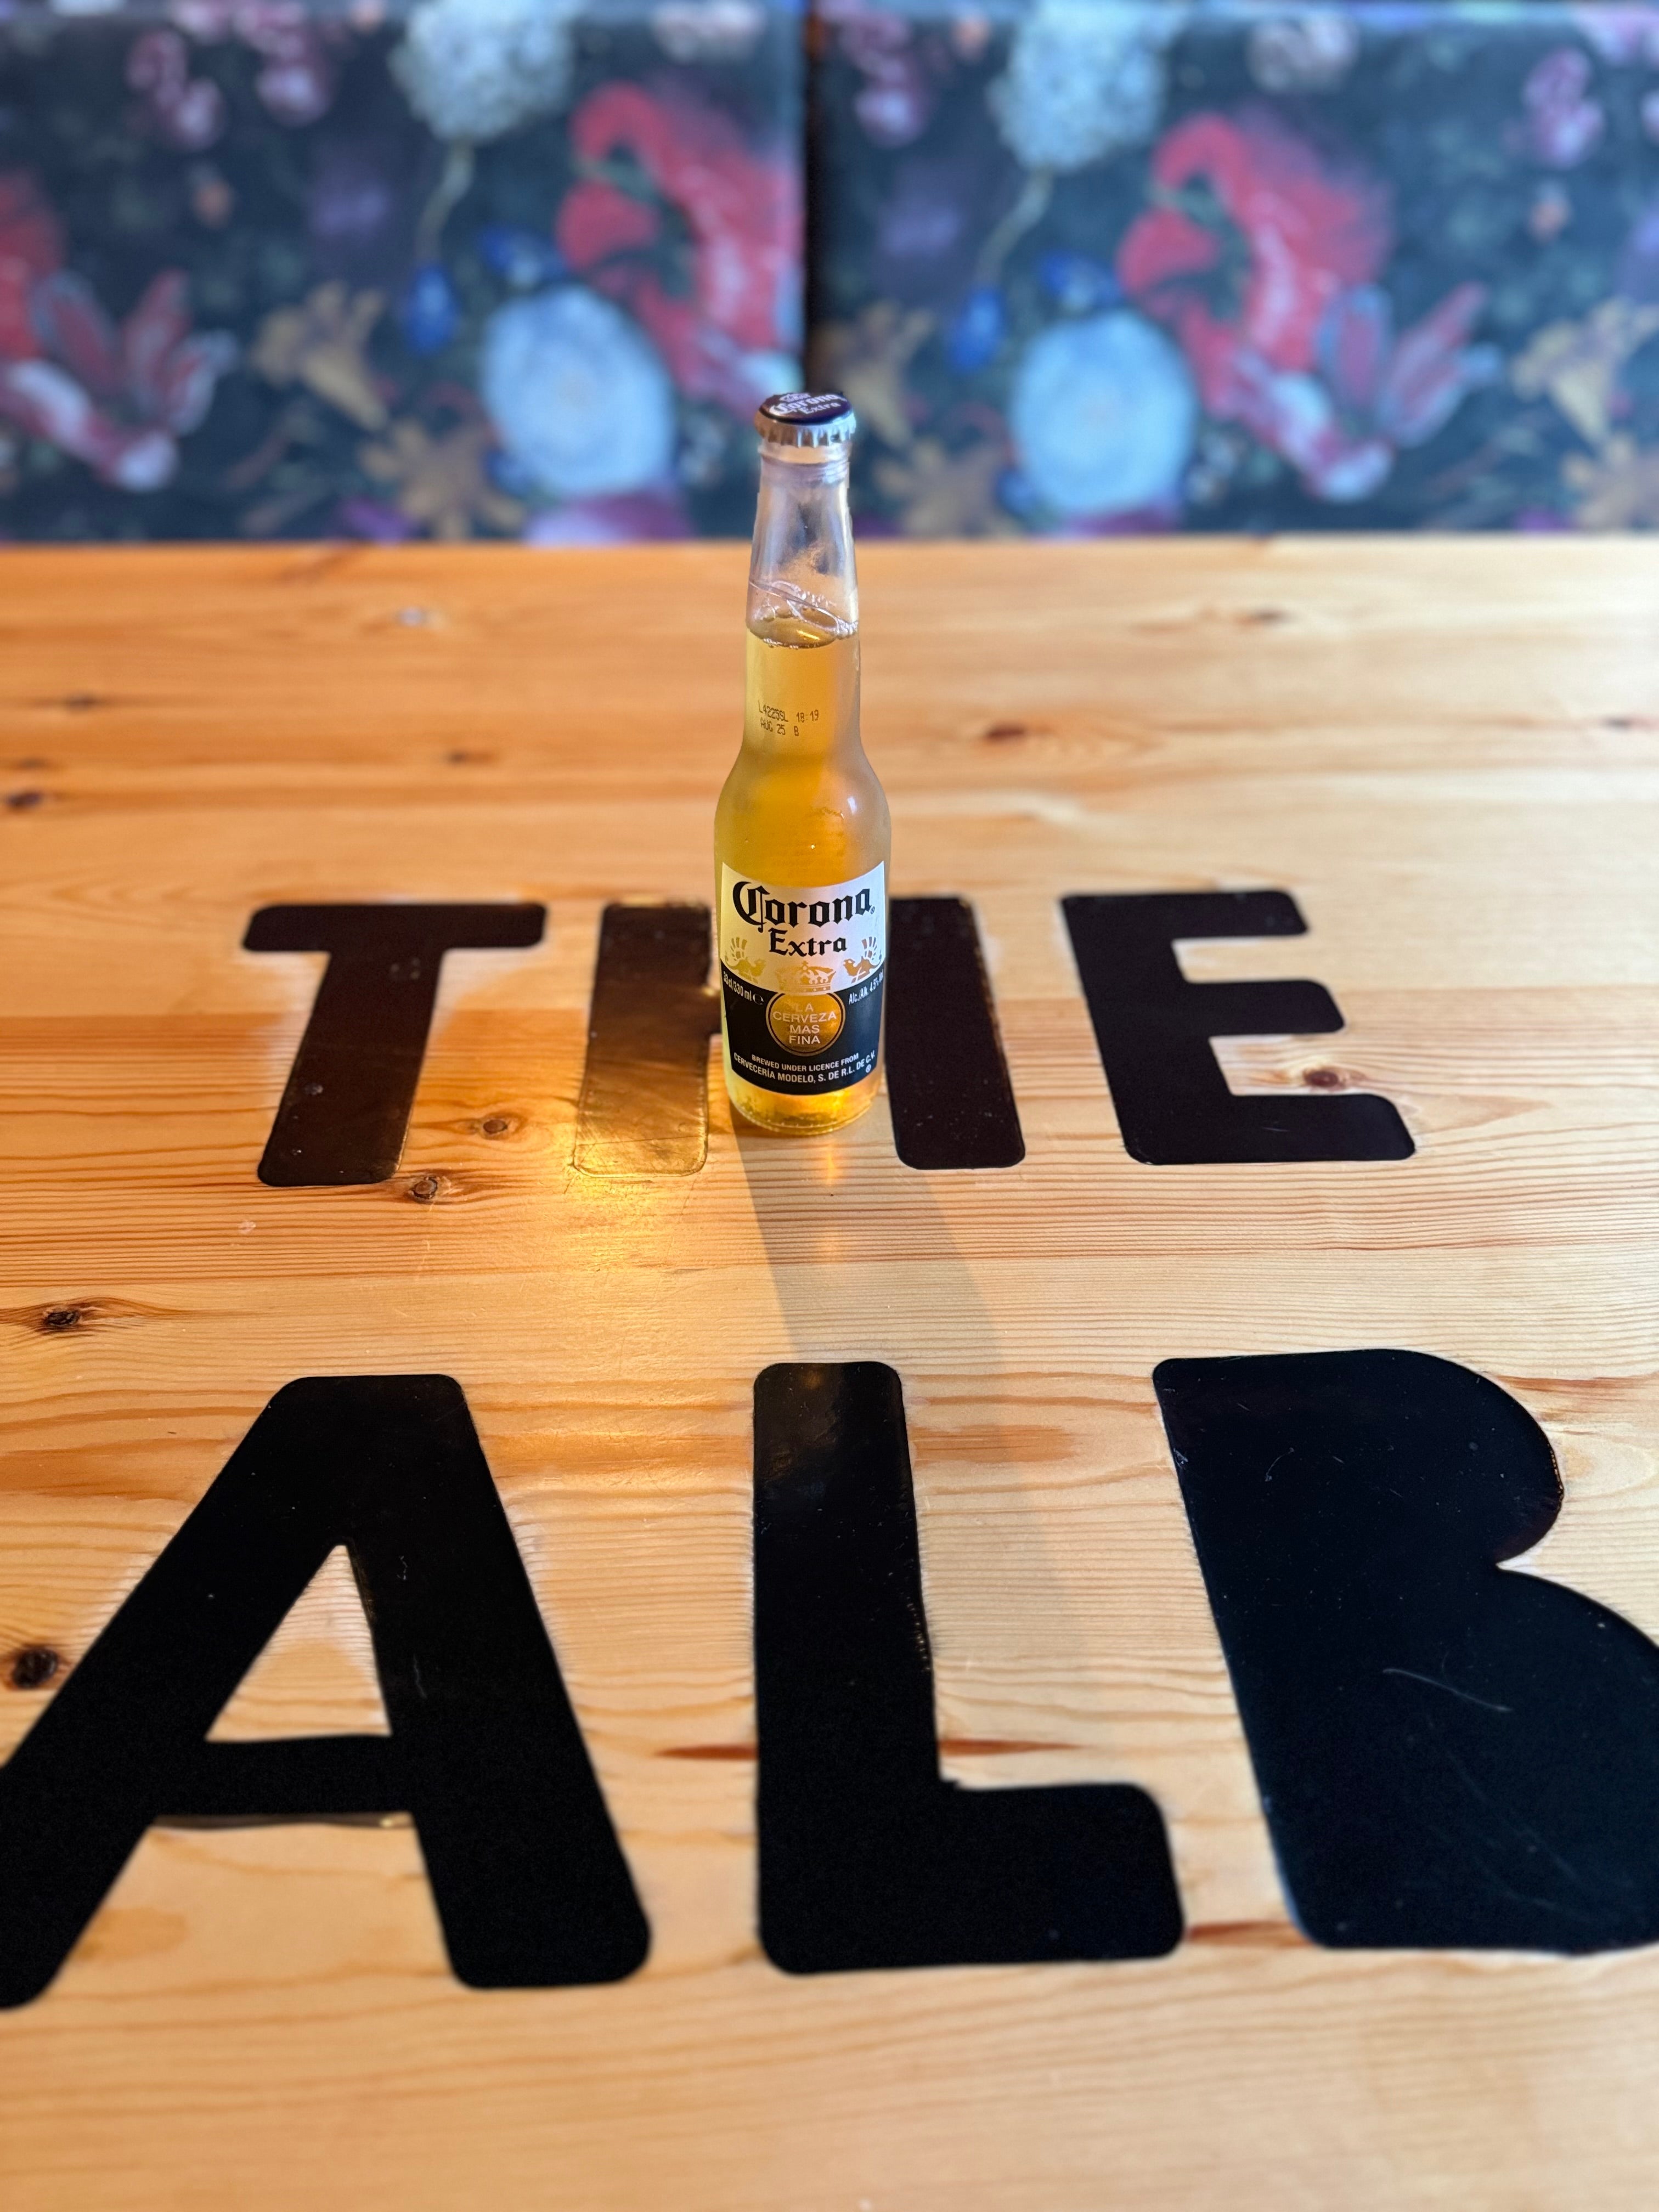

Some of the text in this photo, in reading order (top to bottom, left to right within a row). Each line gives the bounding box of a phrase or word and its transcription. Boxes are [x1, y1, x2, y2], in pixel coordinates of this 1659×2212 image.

[769, 394, 848, 416] Corona
[798, 402, 841, 415] Extra
[777, 724, 786, 736] 25
[733, 881, 872, 933] Corona
[768, 928, 847, 957] Extra
[795, 1003, 814, 1012] LA
[772, 1011, 837, 1023] CERVEZA
[241, 890, 1416, 1186] THE
[790, 1024, 820, 1034] MAS
[789, 1035, 821, 1045] FINA
[752, 1053, 859, 1071] BREWED UNDER LICENCE FROM
[778, 1072, 816, 1084] MODELO,
[818, 1074, 826, 1082] S.
[828, 1070, 839, 1080] DE
[841, 1066, 855, 1077] R.L.
[856, 1059, 865, 1070] DE
[0, 1349, 1659, 2010] ALB
